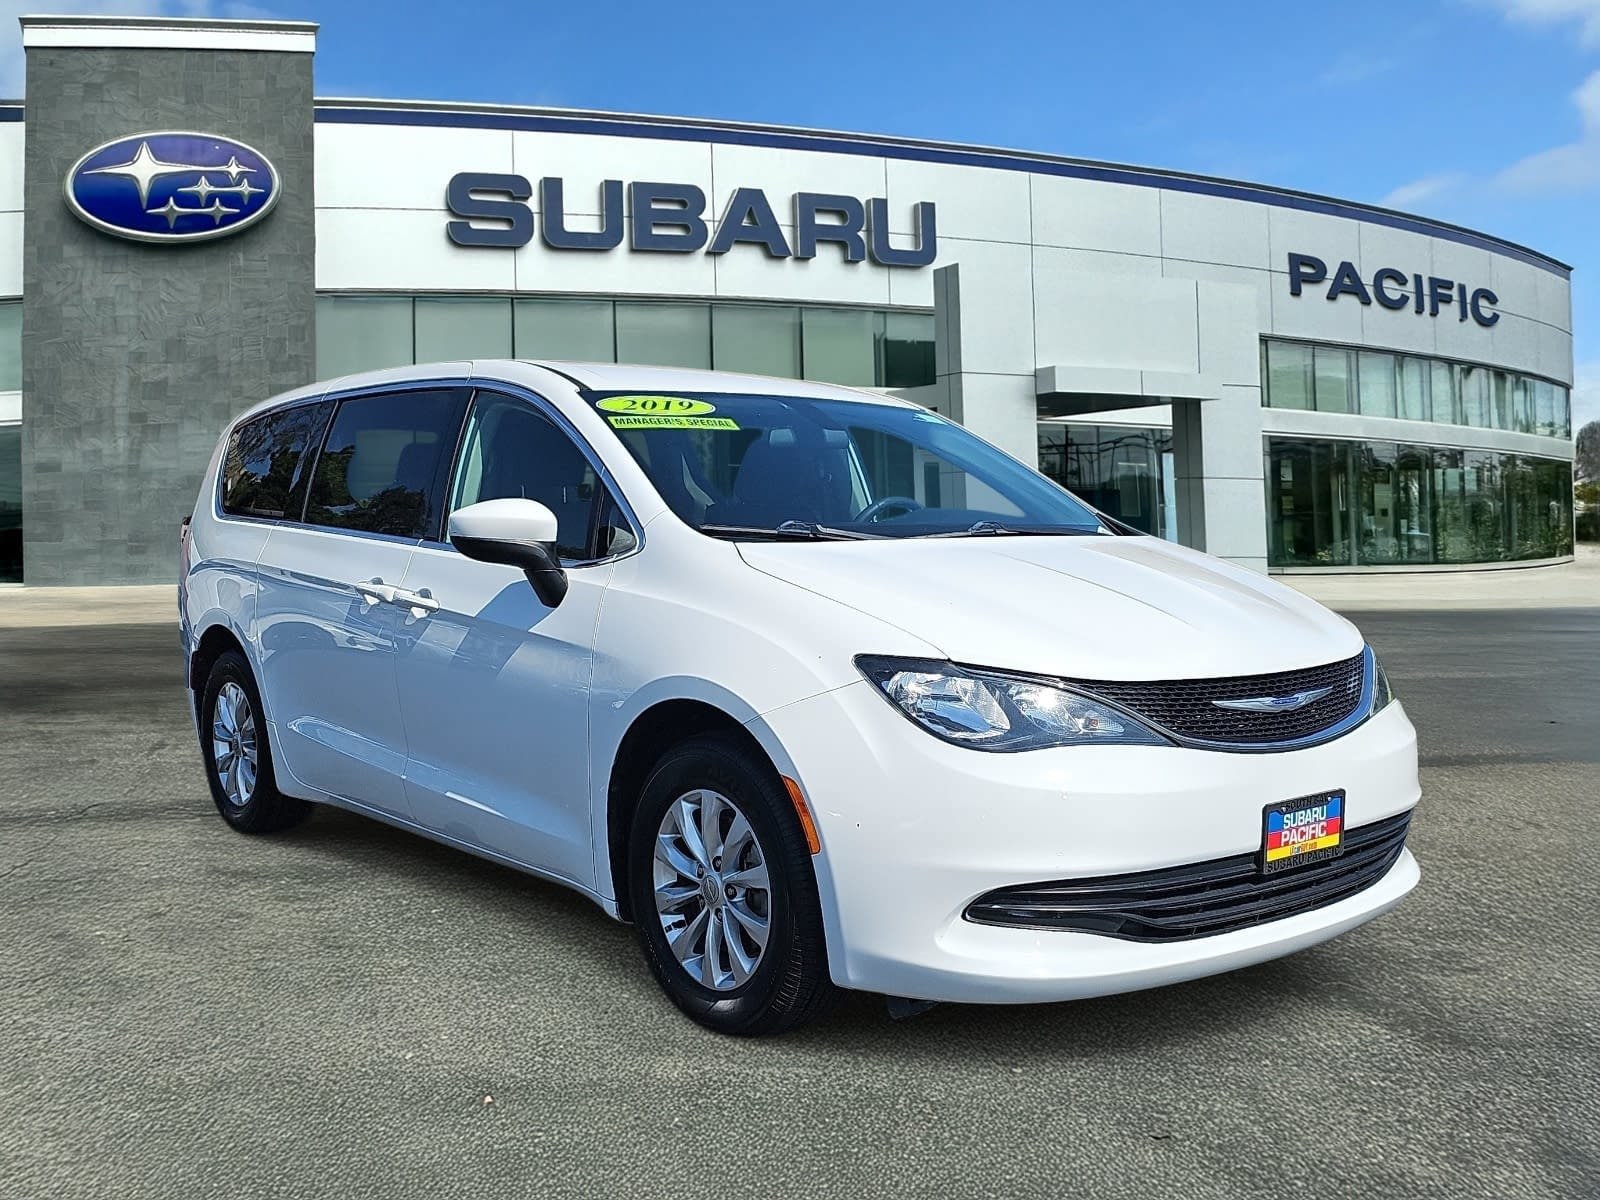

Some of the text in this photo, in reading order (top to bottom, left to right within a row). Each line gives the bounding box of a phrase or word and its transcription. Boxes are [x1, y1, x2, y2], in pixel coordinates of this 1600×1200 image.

[446, 171, 938, 267] SUBARU
[1288, 252, 1500, 327] PACIFIC
[623, 399, 694, 411] 2019
[614, 416, 732, 427] MANAGER'S SPECIAL
[1285, 796, 1313, 811] SOUTH
[1283, 805, 1327, 829] SUBARU
[1281, 822, 1328, 847] PACIFIC
[1266, 853, 1305, 872] SUBARU
[1307, 847, 1340, 863] PACIFIC
